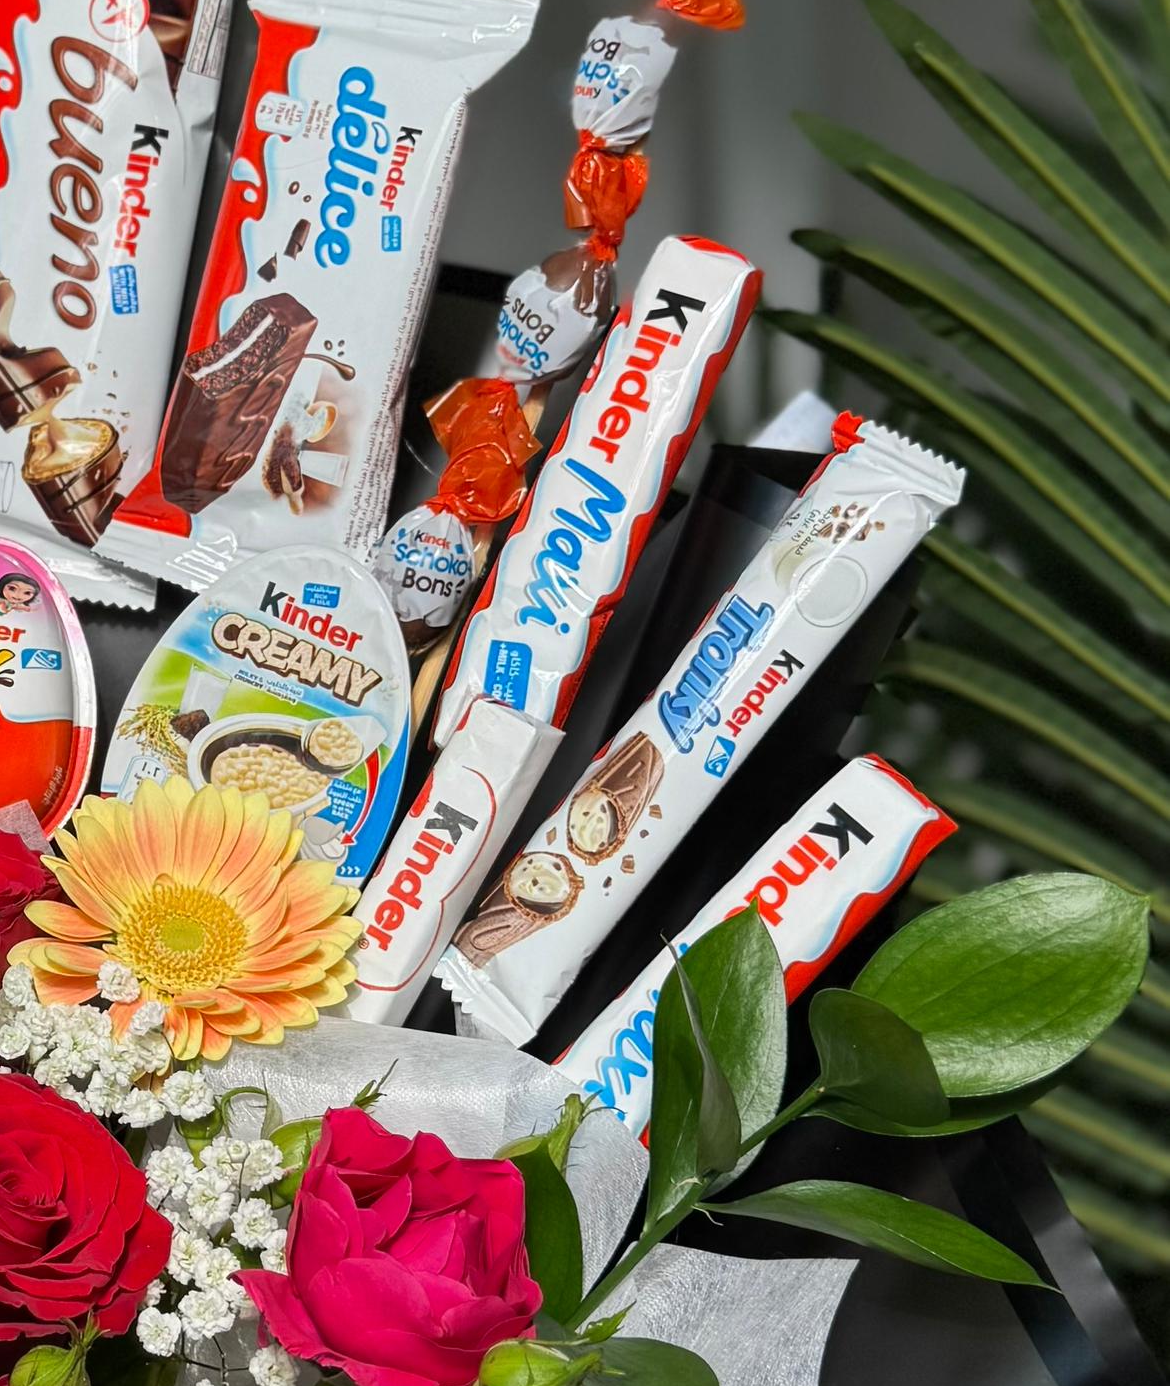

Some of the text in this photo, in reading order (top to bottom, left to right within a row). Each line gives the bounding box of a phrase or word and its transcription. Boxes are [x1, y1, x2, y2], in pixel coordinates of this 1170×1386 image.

[49, 36, 138, 330] bueno
[114, 123, 169, 258] Kinder
[314, 66, 390, 269] délice
[380, 126, 423, 212] Kinder
[511, 297, 555, 345] Bons
[515, 288, 706, 635] Kinder Maxi
[259, 581, 363, 653] Kinder
[401, 567, 453, 597] Bons
[211, 612, 383, 708] CREAMY
[658, 594, 775, 754] Tronky
[725, 649, 805, 737] Kinder
[365, 801, 478, 951] Kinder
[724, 802, 875, 927] Kind
